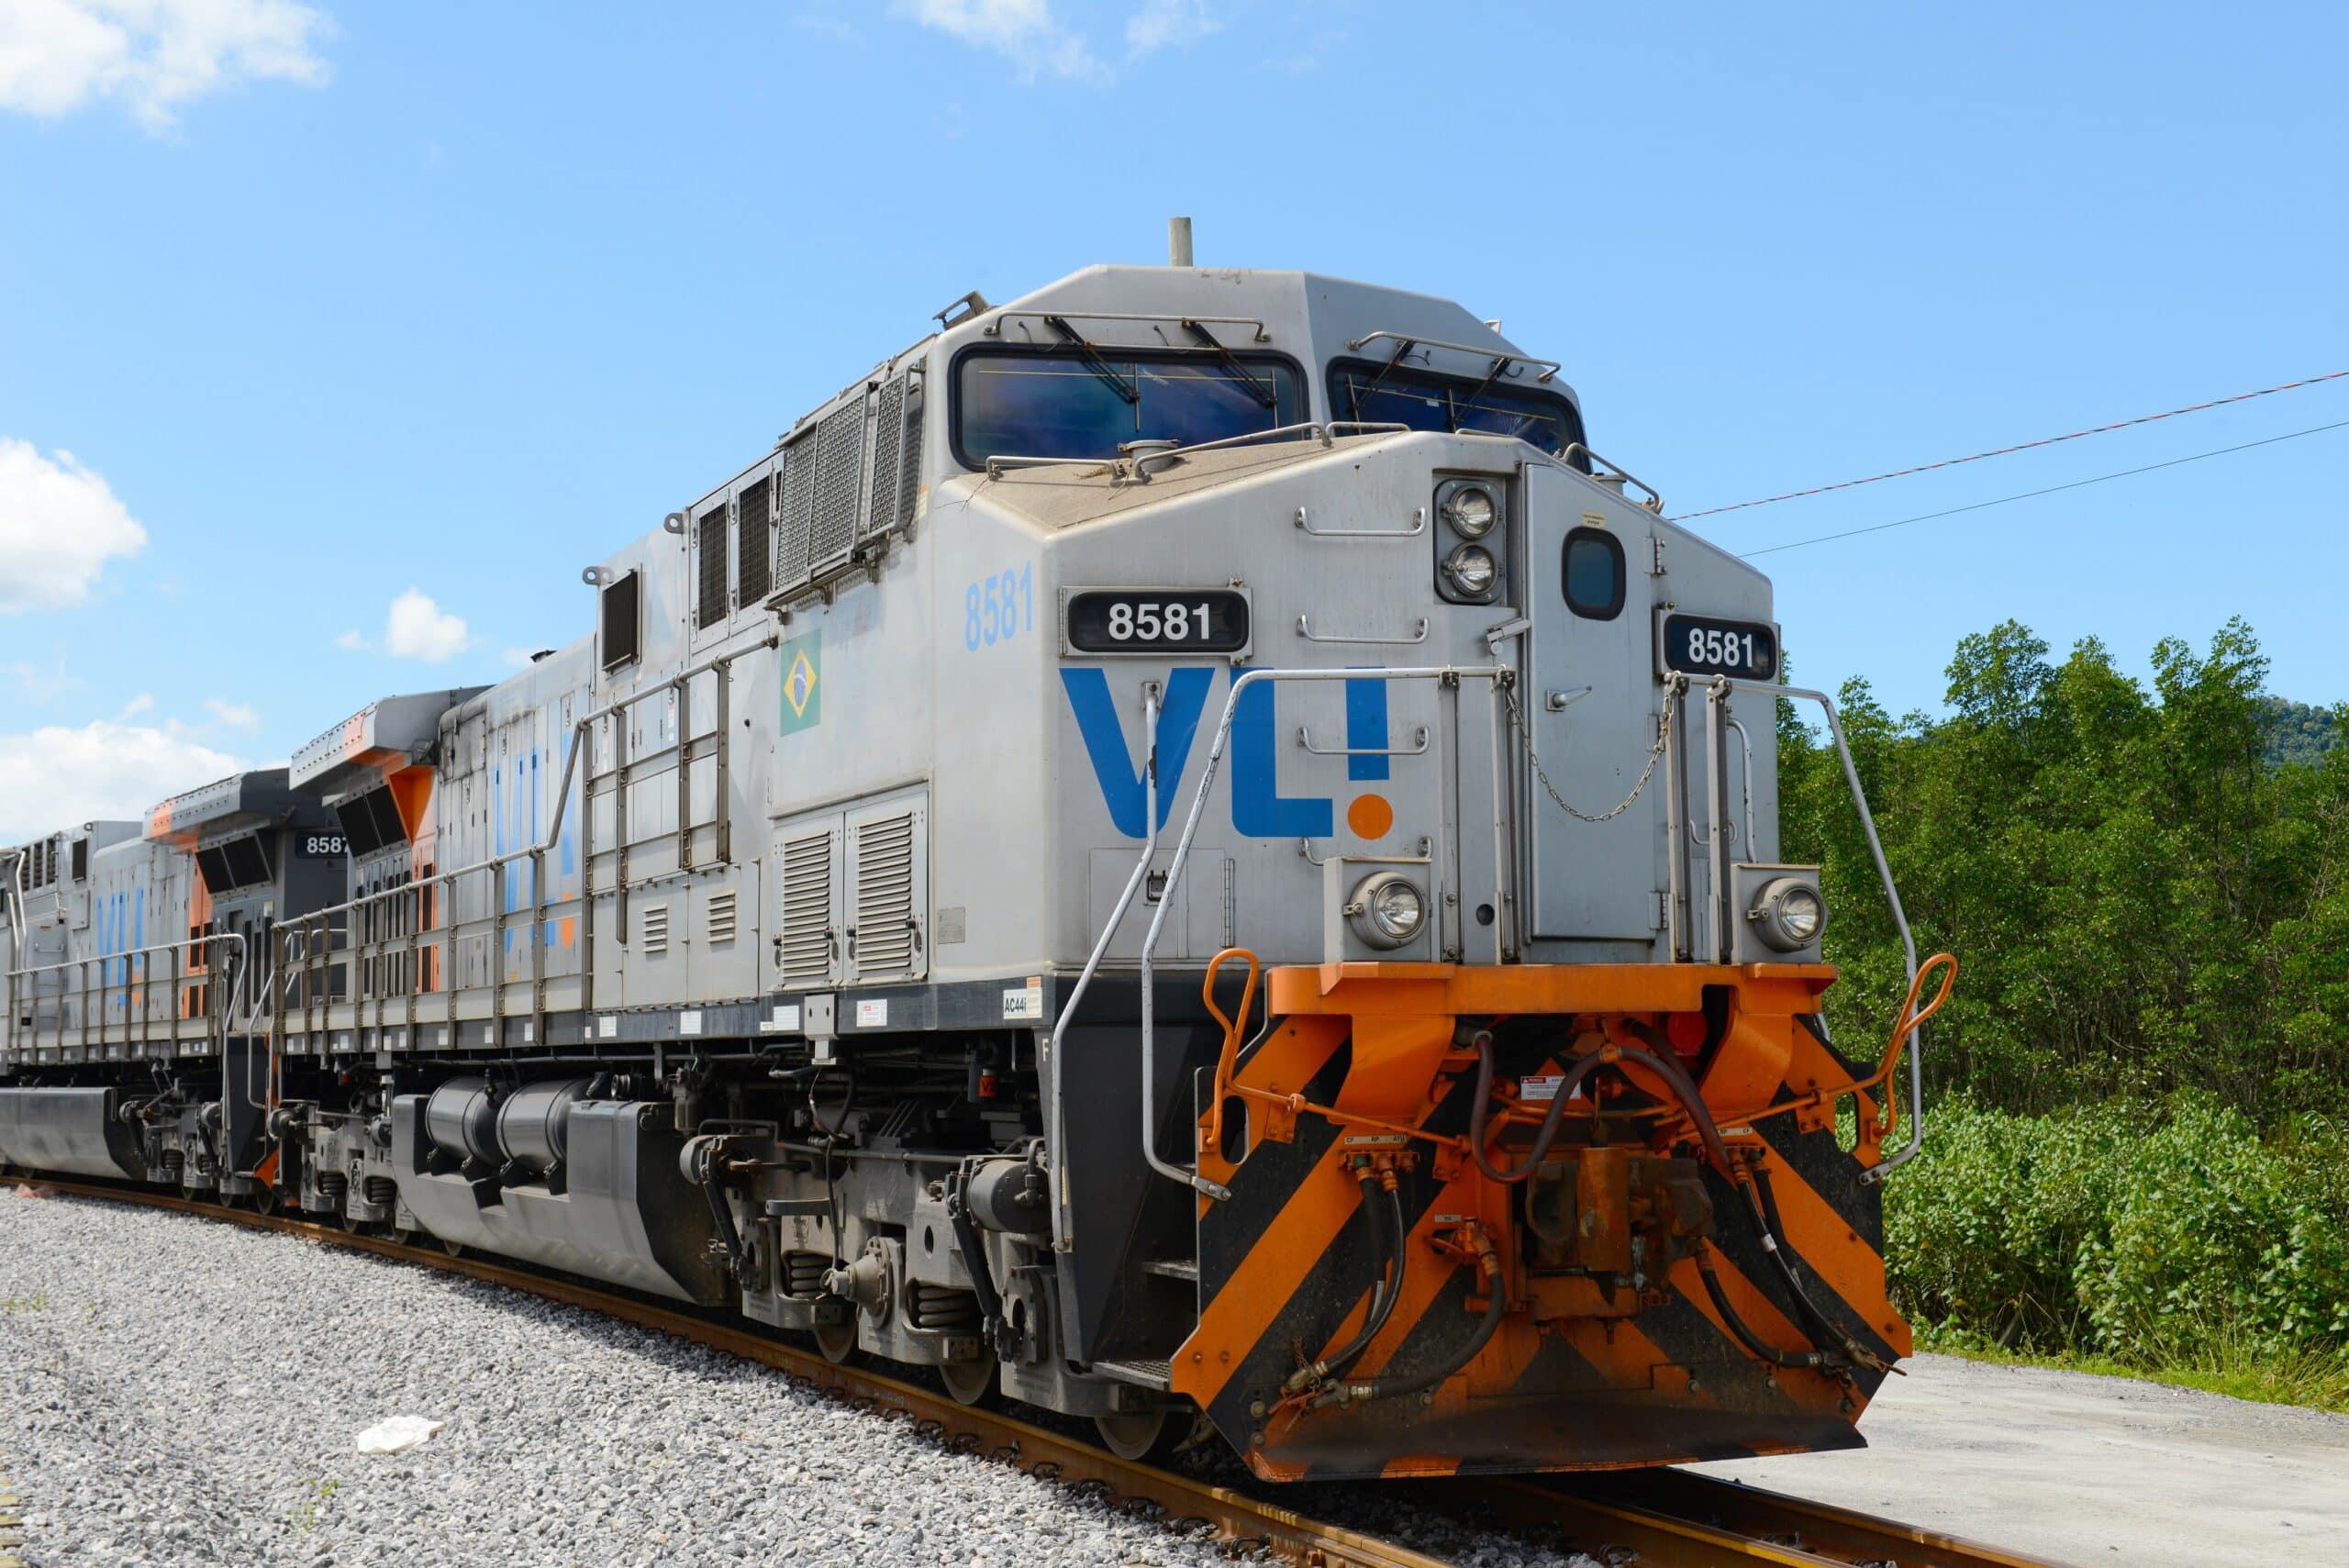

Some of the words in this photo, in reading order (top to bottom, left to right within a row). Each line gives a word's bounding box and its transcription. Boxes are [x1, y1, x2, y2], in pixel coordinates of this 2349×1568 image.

[964, 560, 1032, 652] 8581
[1108, 603, 1209, 640] 8581
[1688, 628, 1753, 668] 8581
[1042, 1038, 1049, 1062] F
